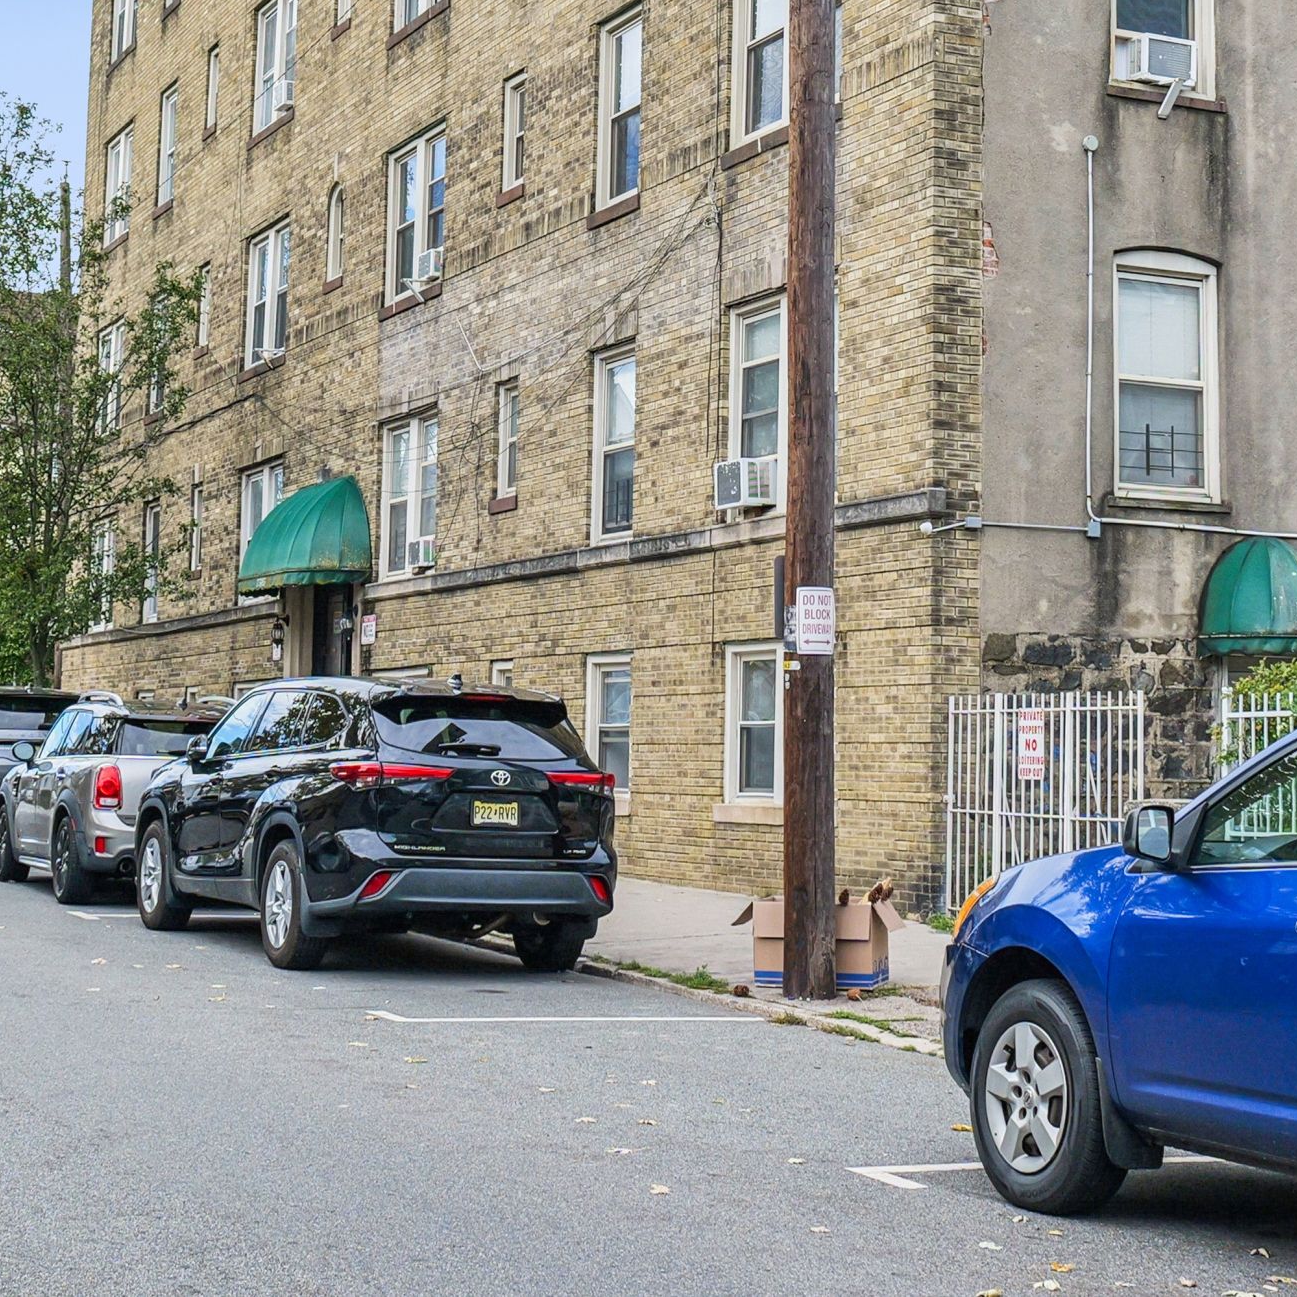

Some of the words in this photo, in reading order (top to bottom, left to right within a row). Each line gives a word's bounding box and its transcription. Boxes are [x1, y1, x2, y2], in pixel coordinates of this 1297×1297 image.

[802, 594, 816, 606] DO
[817, 594, 832, 606] NOT
[804, 608, 832, 620] BLOCK
[802, 623, 832, 635] DRIVEWAY
[1019, 711, 1043, 721] PRIVATE
[1018, 725, 1044, 735] PROPERTY
[1025, 738, 1038, 752] NO
[1018, 755, 1044, 765] LOITERING
[1019, 767, 1032, 777] KEEP
[1033, 767, 1043, 778] OUT
